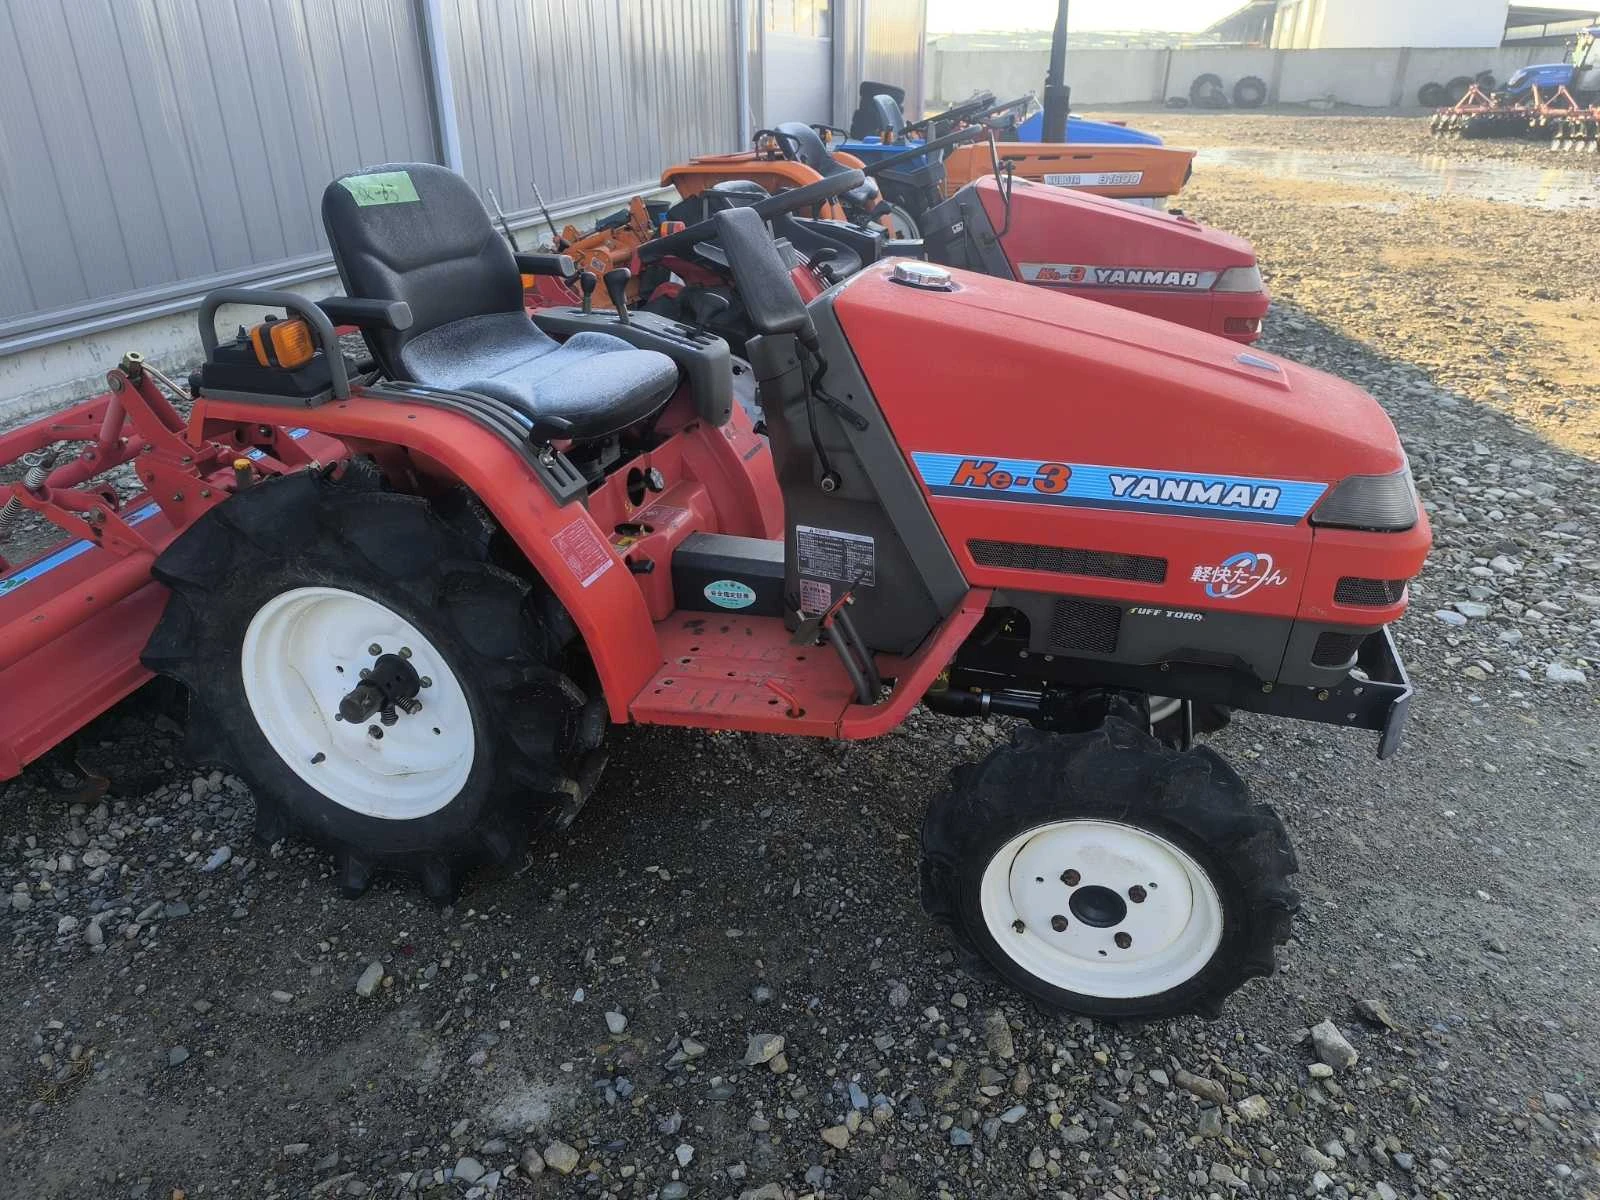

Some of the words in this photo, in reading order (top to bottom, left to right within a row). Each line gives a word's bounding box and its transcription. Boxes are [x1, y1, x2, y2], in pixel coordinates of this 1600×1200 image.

[1046, 174, 1080, 185] KUBOTA
[1095, 268, 1200, 288] YANMAR
[949, 459, 1072, 494] Ke-3
[1108, 473, 1282, 511] YANMAR
[1128, 606, 1162, 617] TUFF
[1165, 609, 1204, 622] TORQ
